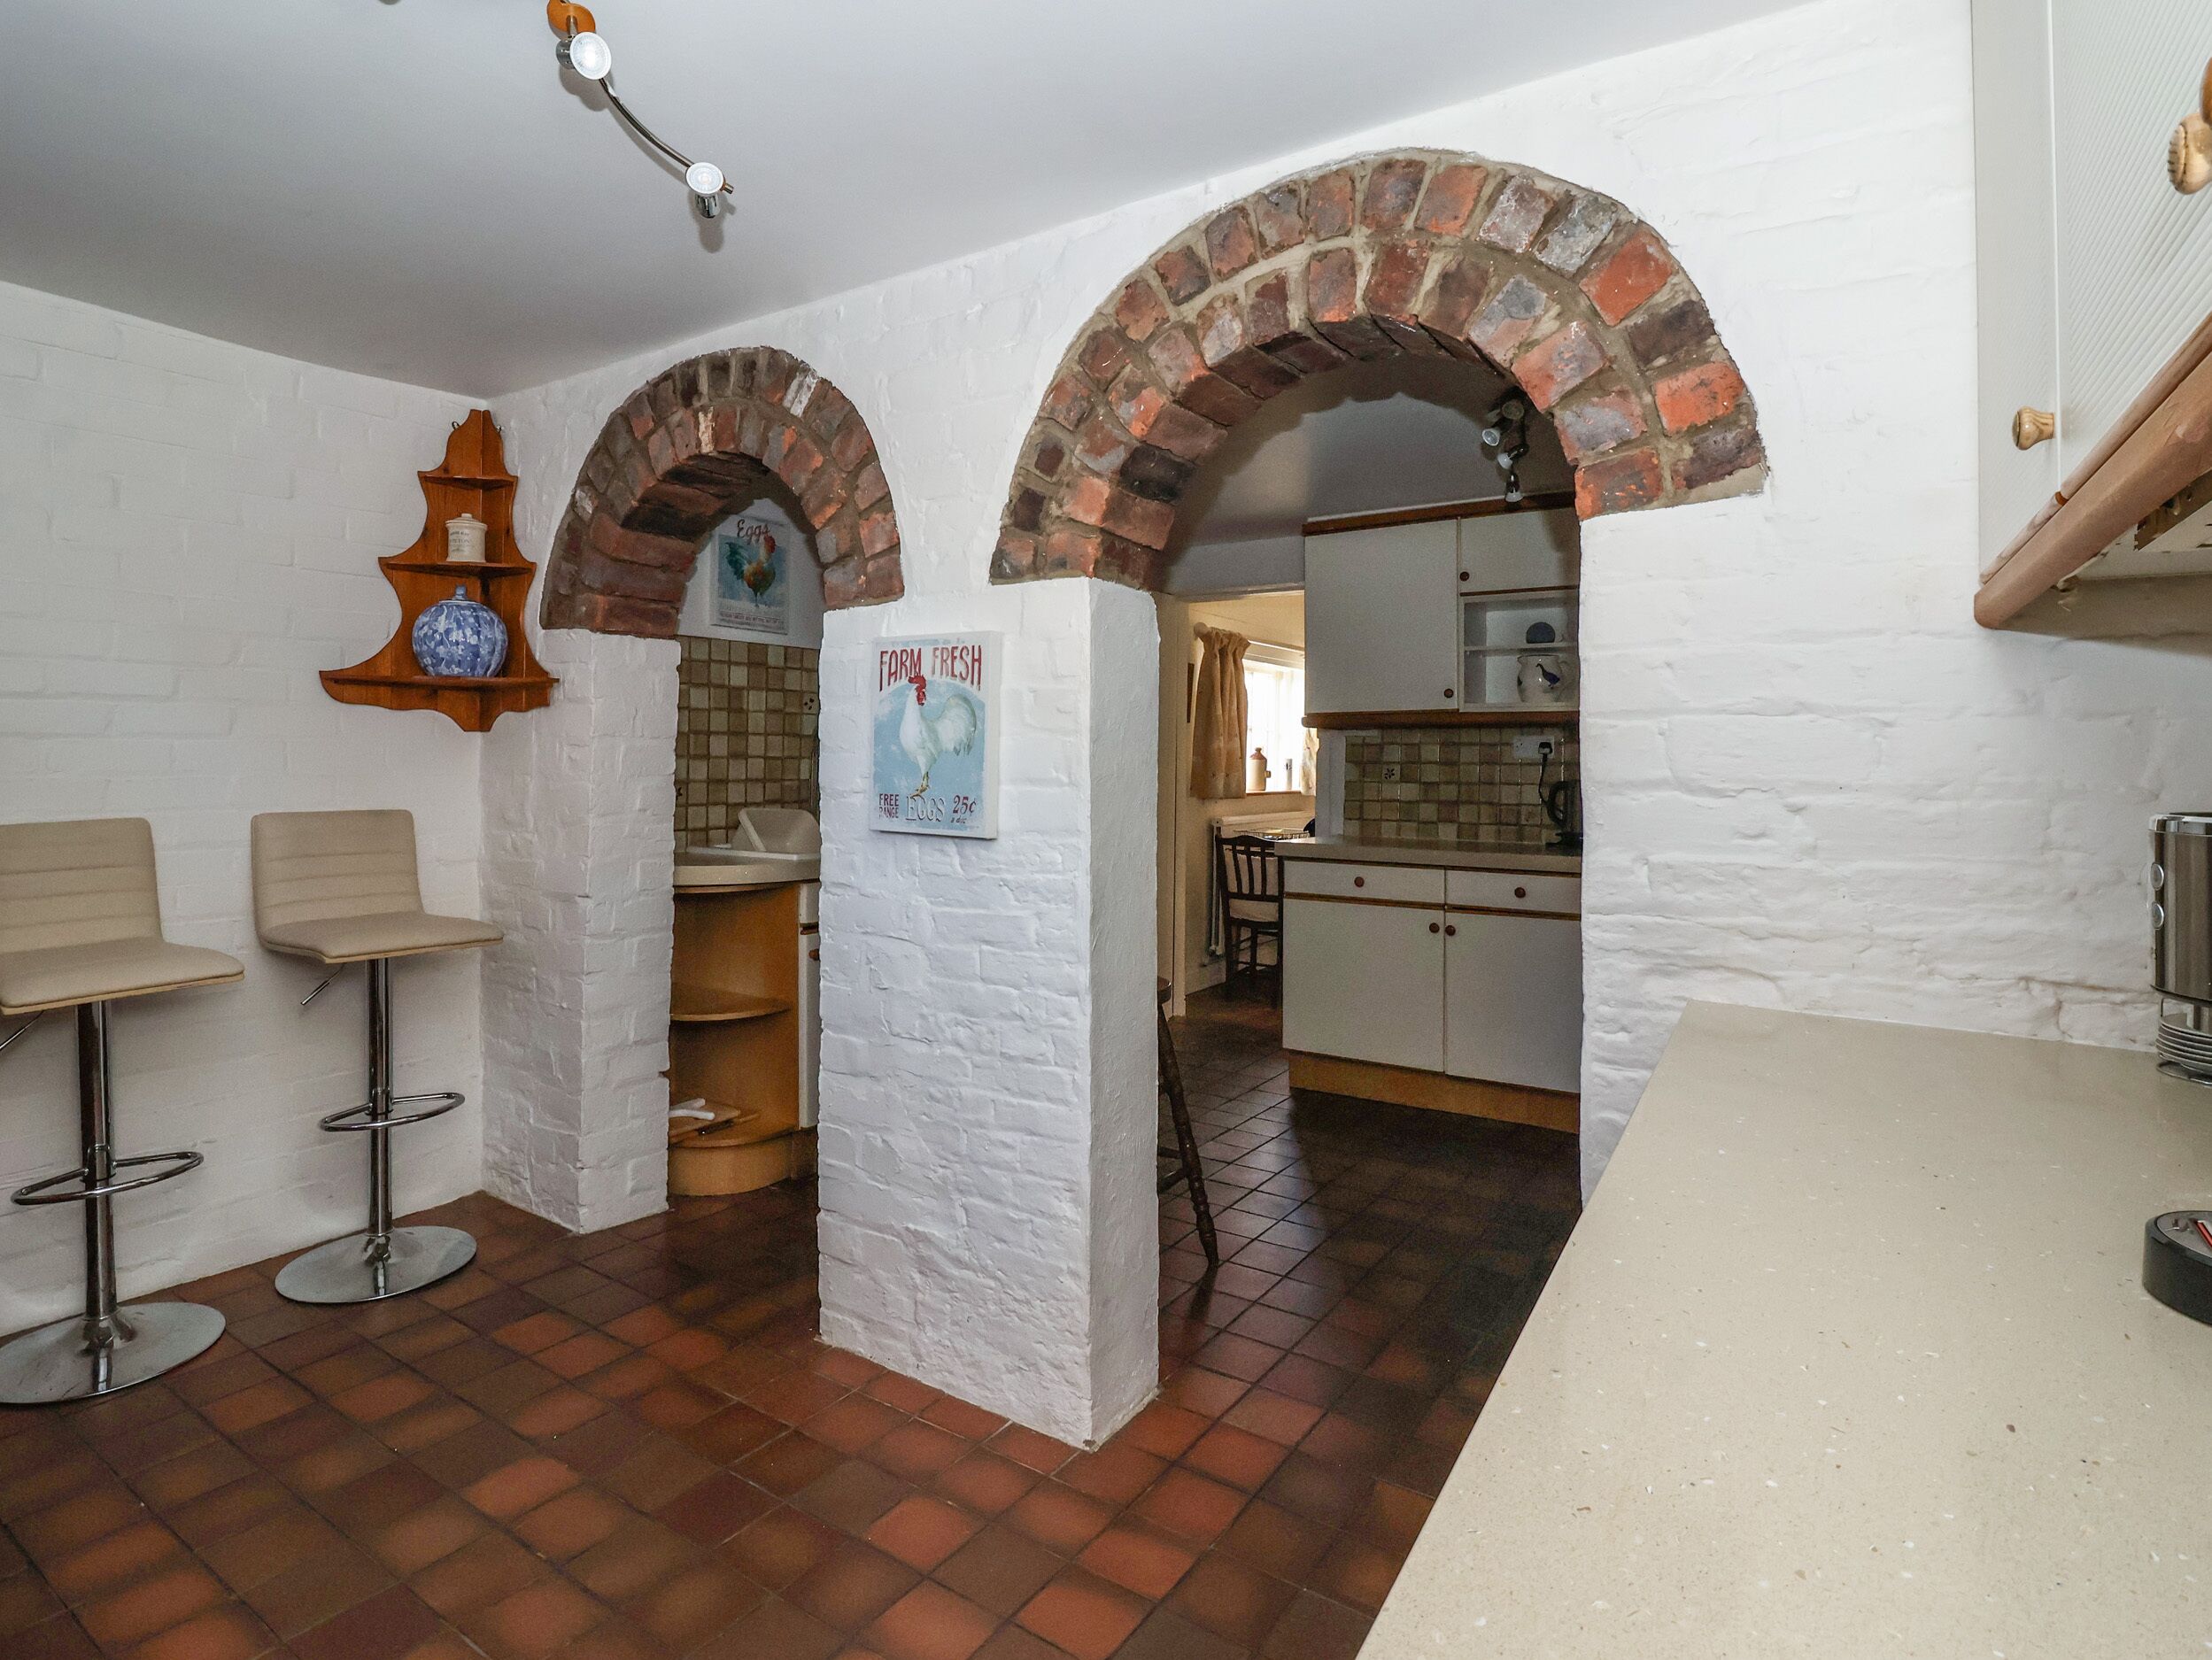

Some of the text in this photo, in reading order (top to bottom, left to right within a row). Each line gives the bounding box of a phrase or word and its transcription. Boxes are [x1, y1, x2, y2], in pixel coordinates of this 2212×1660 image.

[737, 519, 770, 545] Eggs
[879, 645, 982, 691] FARM FRESH
[879, 793, 900, 807] FREE
[905, 794, 946, 822] EGGS
[952, 794, 977, 816] 25¢
